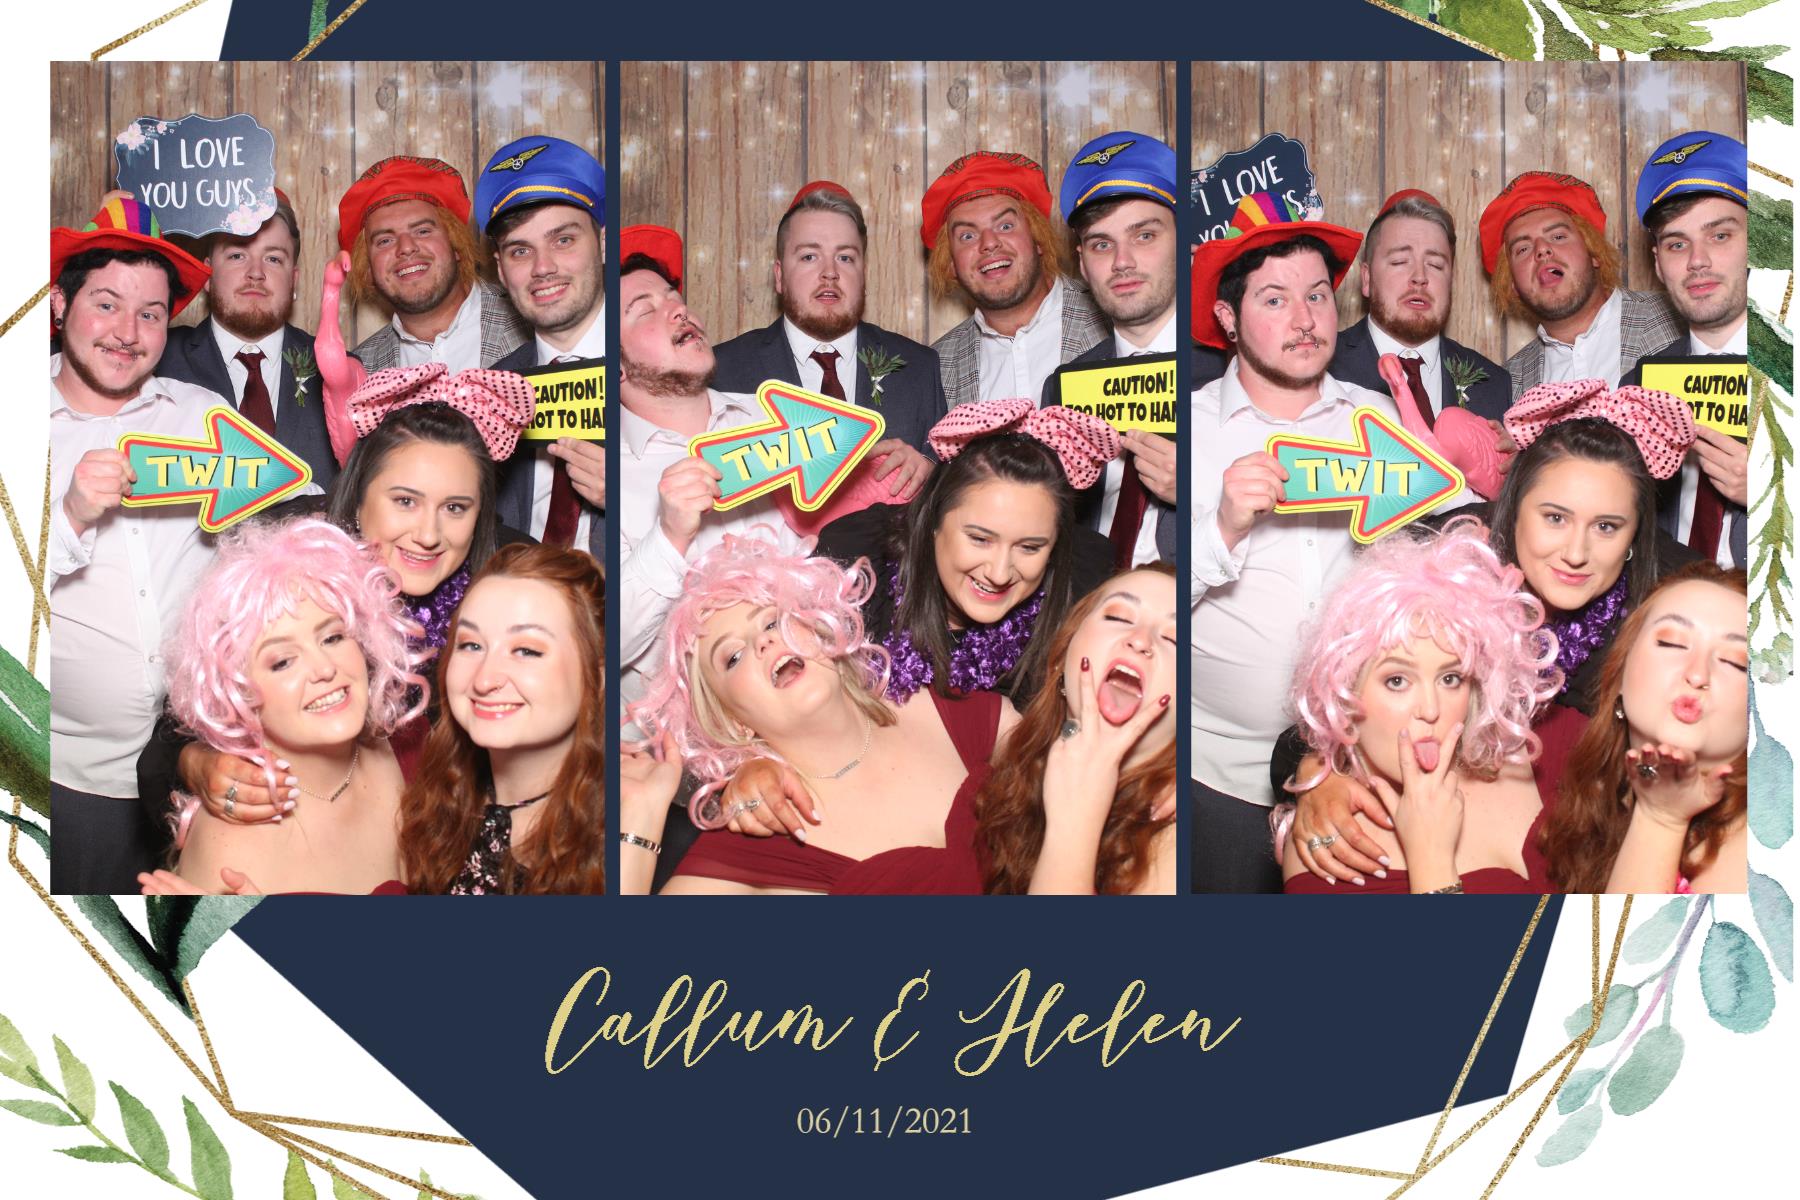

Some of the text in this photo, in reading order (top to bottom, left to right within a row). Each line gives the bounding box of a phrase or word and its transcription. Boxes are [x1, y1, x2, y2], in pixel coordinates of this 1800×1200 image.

[153, 136, 245, 170] I LOVE
[140, 177, 257, 209] YOU GUYS
[1199, 189, 1212, 216] I
[1221, 155, 1284, 205] LOVE
[1198, 220, 1231, 243] YO
[1103, 369, 1174, 396] CAUTION!
[1683, 374, 1747, 396] CAUTION
[557, 409, 578, 429] TO
[1096, 402, 1125, 421] HOT
[1127, 402, 1148, 421] TO
[1706, 401, 1725, 423] TO
[1727, 403, 1747, 426] HA
[720, 416, 838, 481] TWIT
[146, 454, 269, 489] TWIT
[1294, 457, 1420, 497] TWIT
